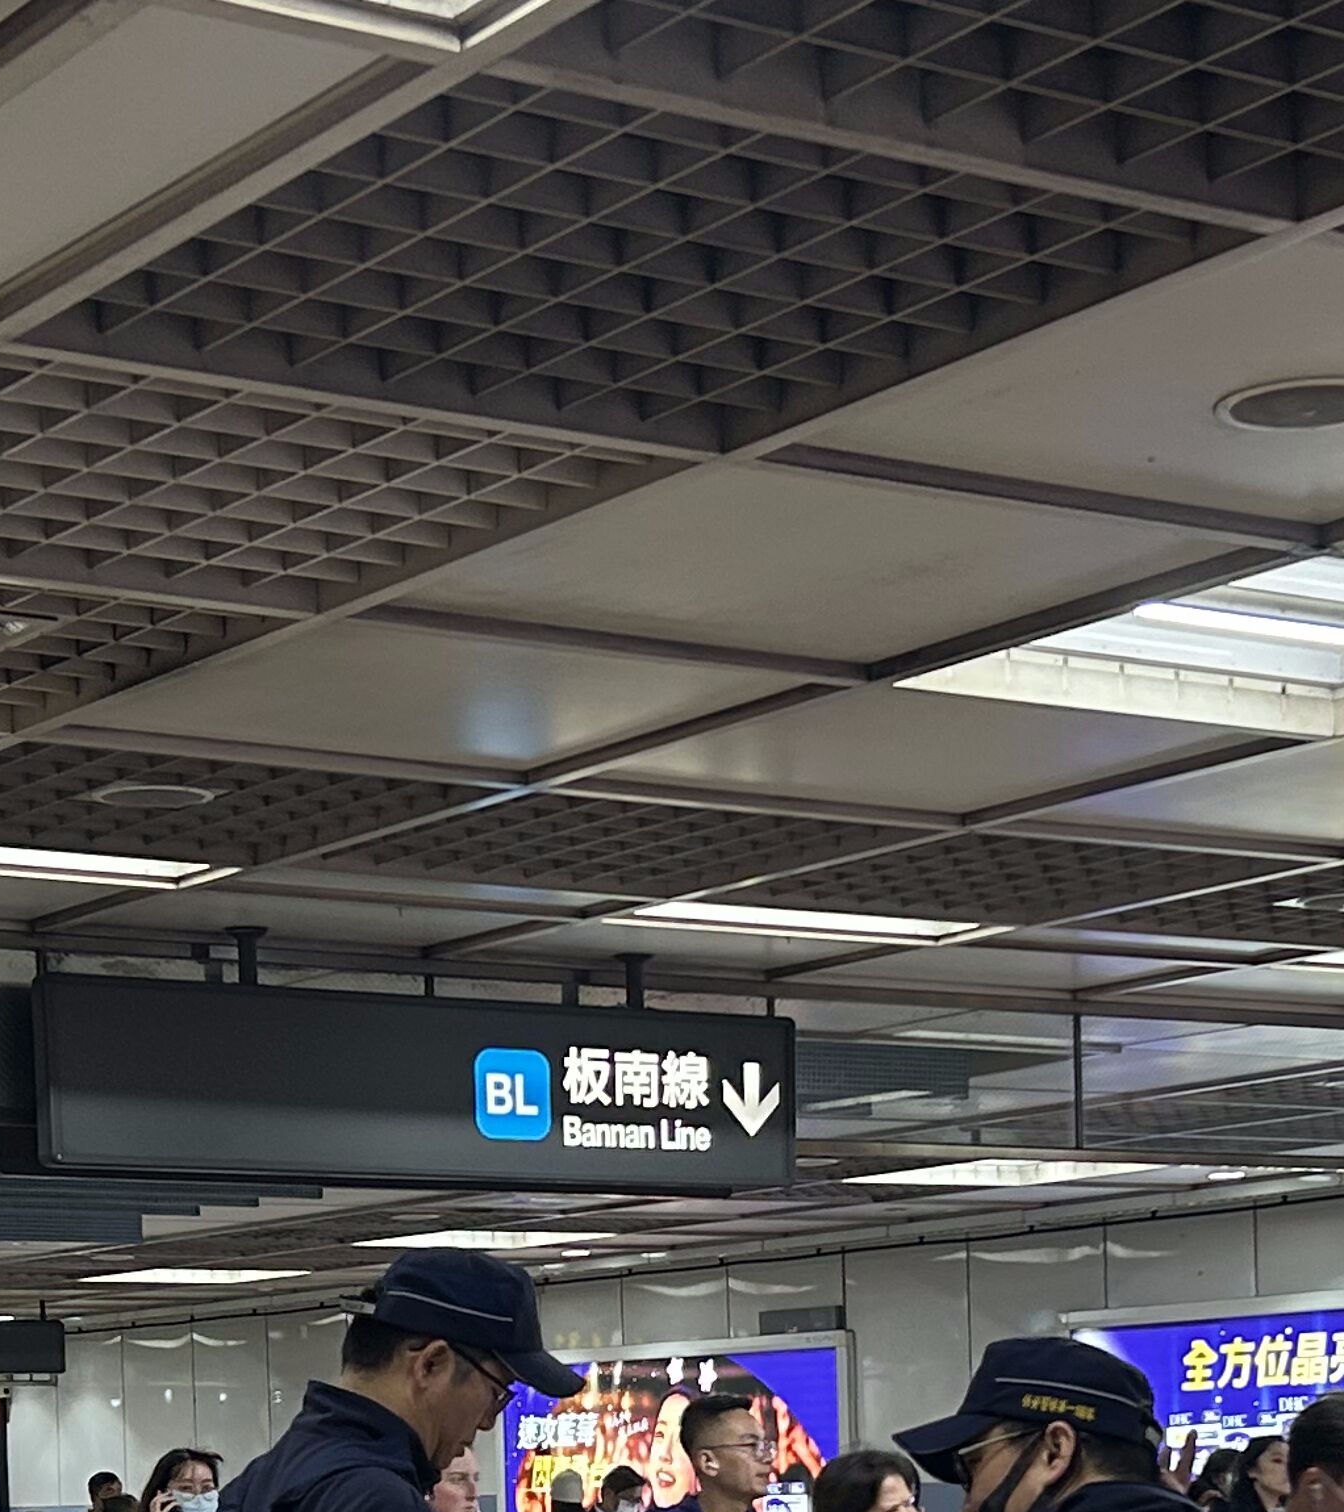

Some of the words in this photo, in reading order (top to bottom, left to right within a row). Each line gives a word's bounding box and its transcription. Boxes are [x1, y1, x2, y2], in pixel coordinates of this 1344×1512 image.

[485, 1072, 540, 1117] BL
[563, 1046, 710, 1110] 板南線
[562, 1115, 656, 1150] Bannan
[660, 1118, 713, 1151] Line
[1279, 1397, 1309, 1412] DHC
